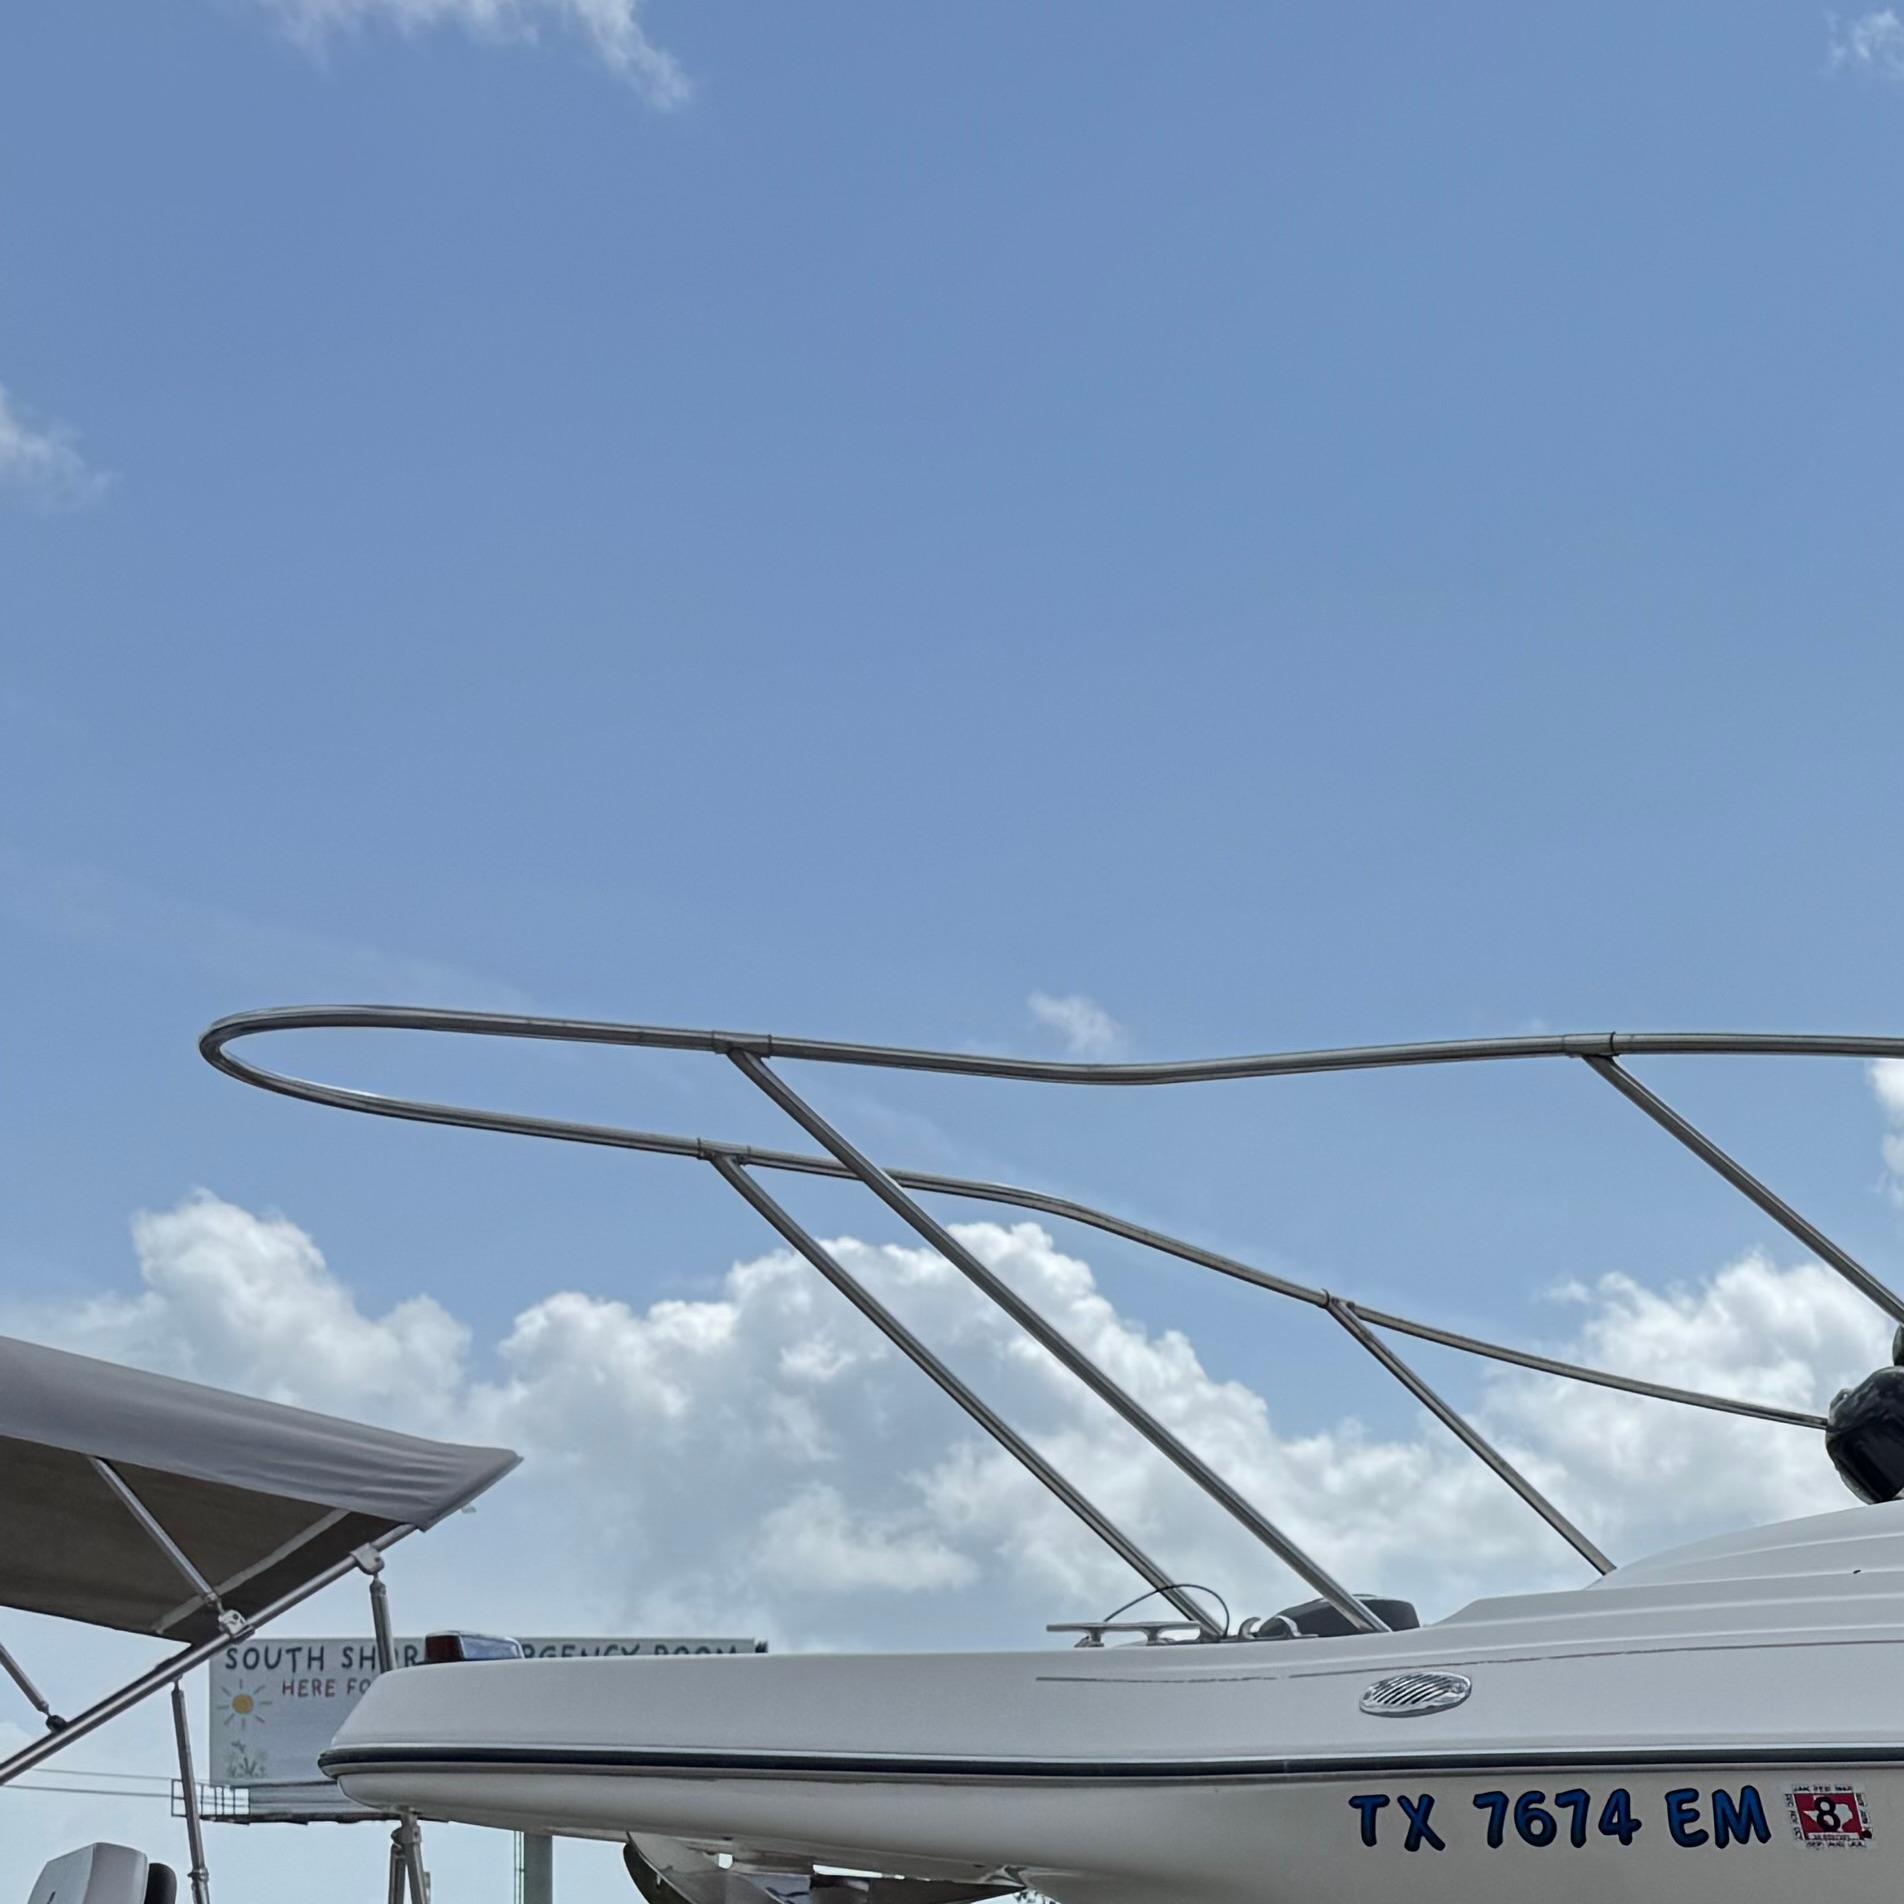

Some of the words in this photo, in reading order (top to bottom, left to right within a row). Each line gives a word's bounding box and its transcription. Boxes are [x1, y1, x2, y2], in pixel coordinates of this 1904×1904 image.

[225, 1645, 325, 1673] SOUTH
[281, 1677, 336, 1698] HERE
[1348, 1793, 1447, 1852] TX
[1472, 1788, 1642, 1849] 7674
[1664, 1785, 1772, 1849] EM
[1815, 1796, 1841, 1832] 8
